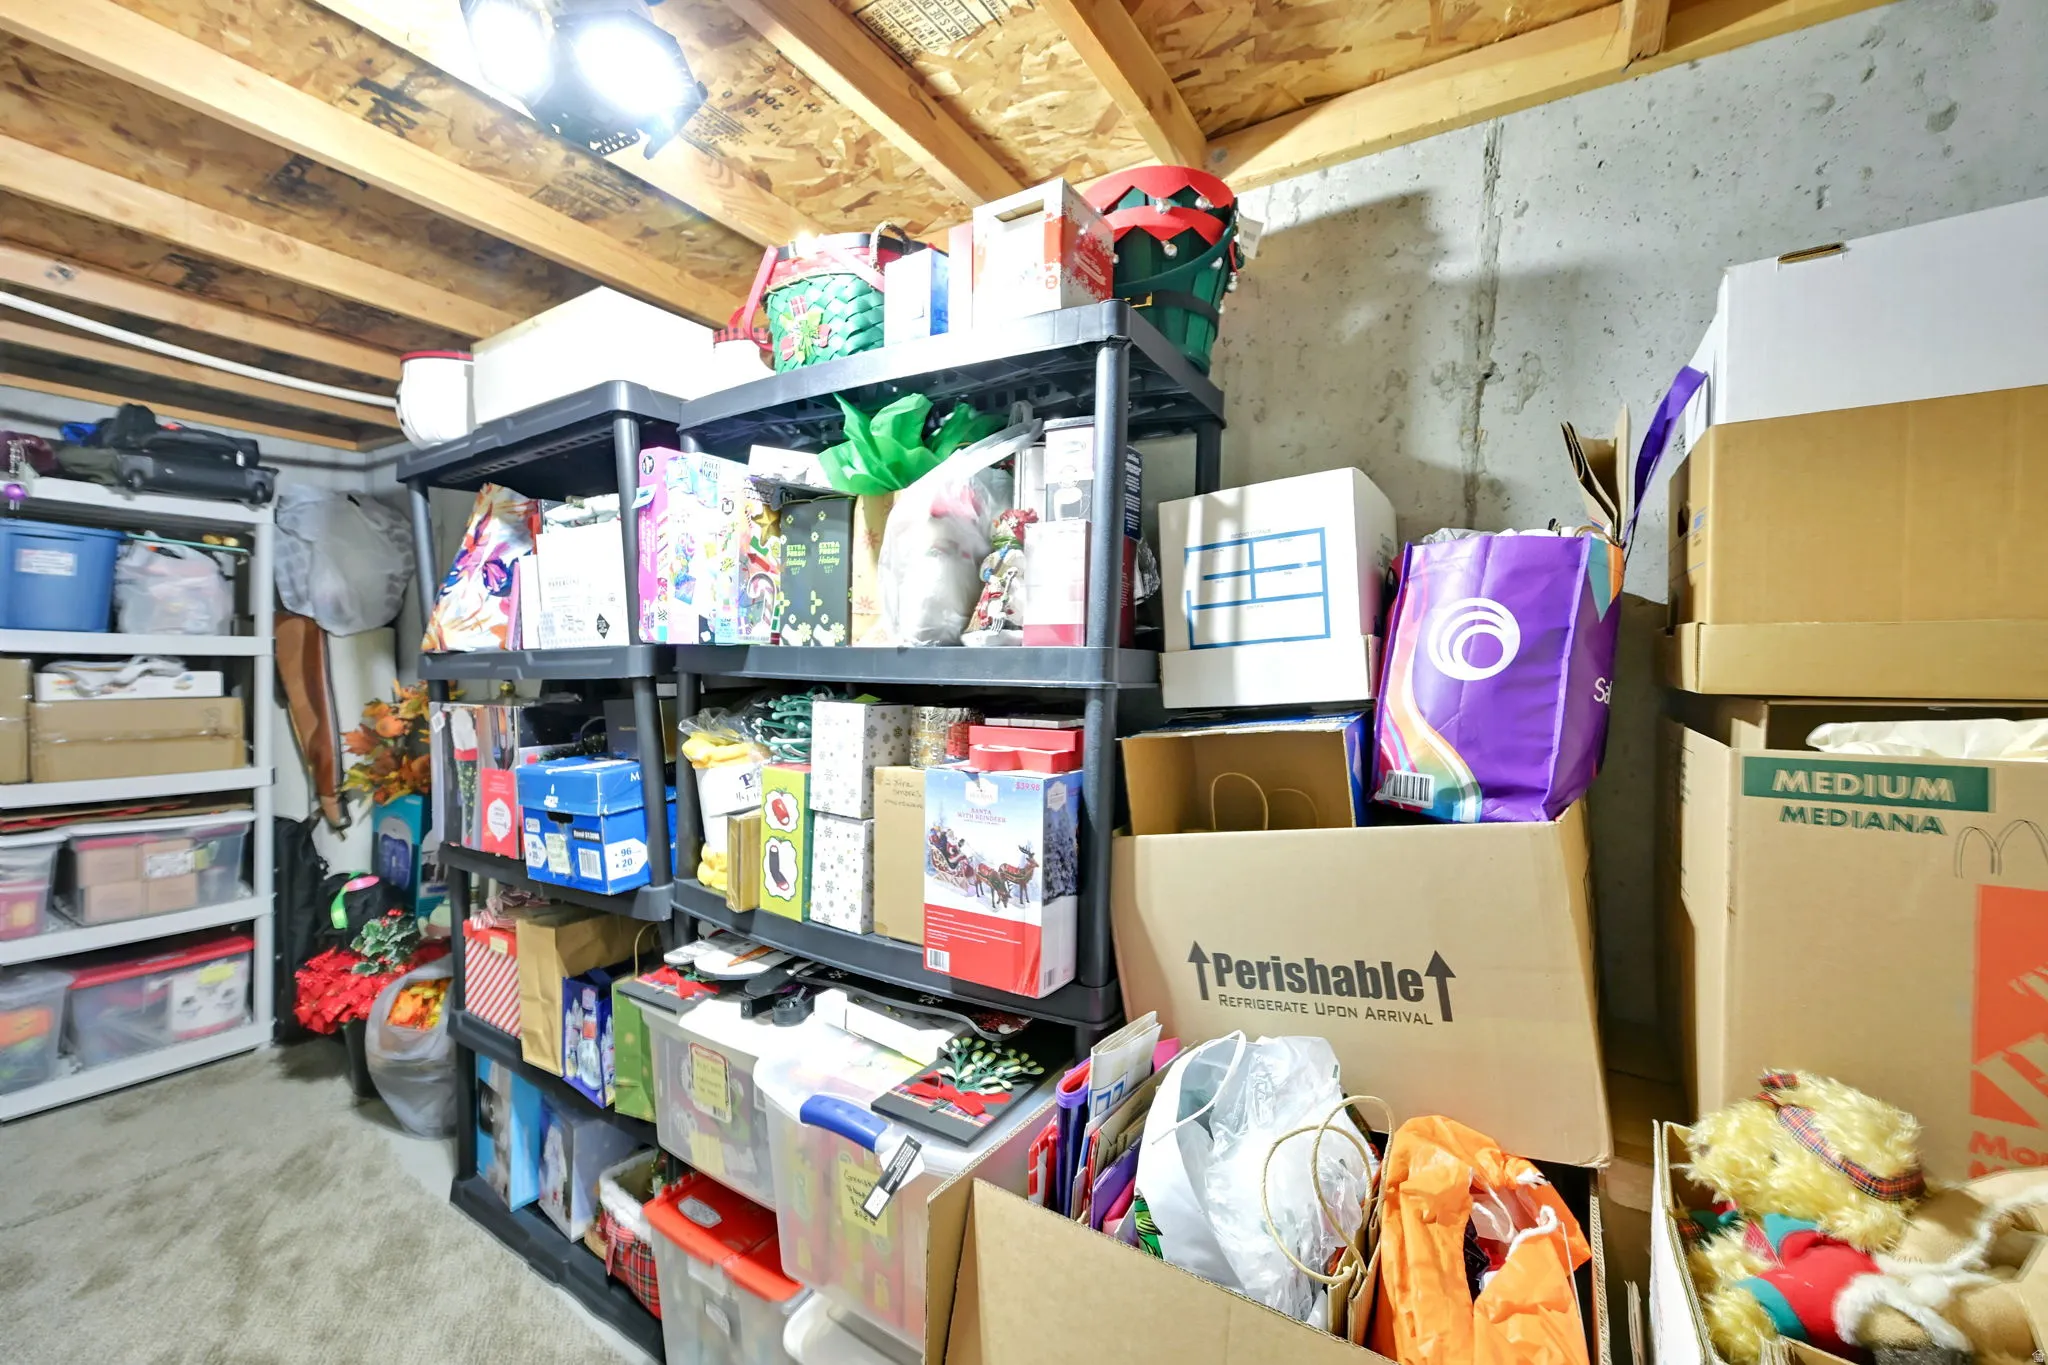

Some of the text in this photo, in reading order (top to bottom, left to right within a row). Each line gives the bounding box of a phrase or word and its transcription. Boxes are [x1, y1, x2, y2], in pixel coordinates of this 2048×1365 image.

[1015, 781, 1040, 791] $39.98
[1772, 769, 1956, 802] MEDIUM
[970, 807, 992, 816] SANTA
[975, 814, 1007, 823] REINDEER
[1778, 805, 1948, 836] MEDIANA
[620, 847, 632, 857] 96
[621, 857, 633, 869] 20
[1212, 952, 1424, 1002] Perishable
[1315, 1002, 1358, 1019] UPON
[1365, 1006, 1433, 1026] ARRIVAL
